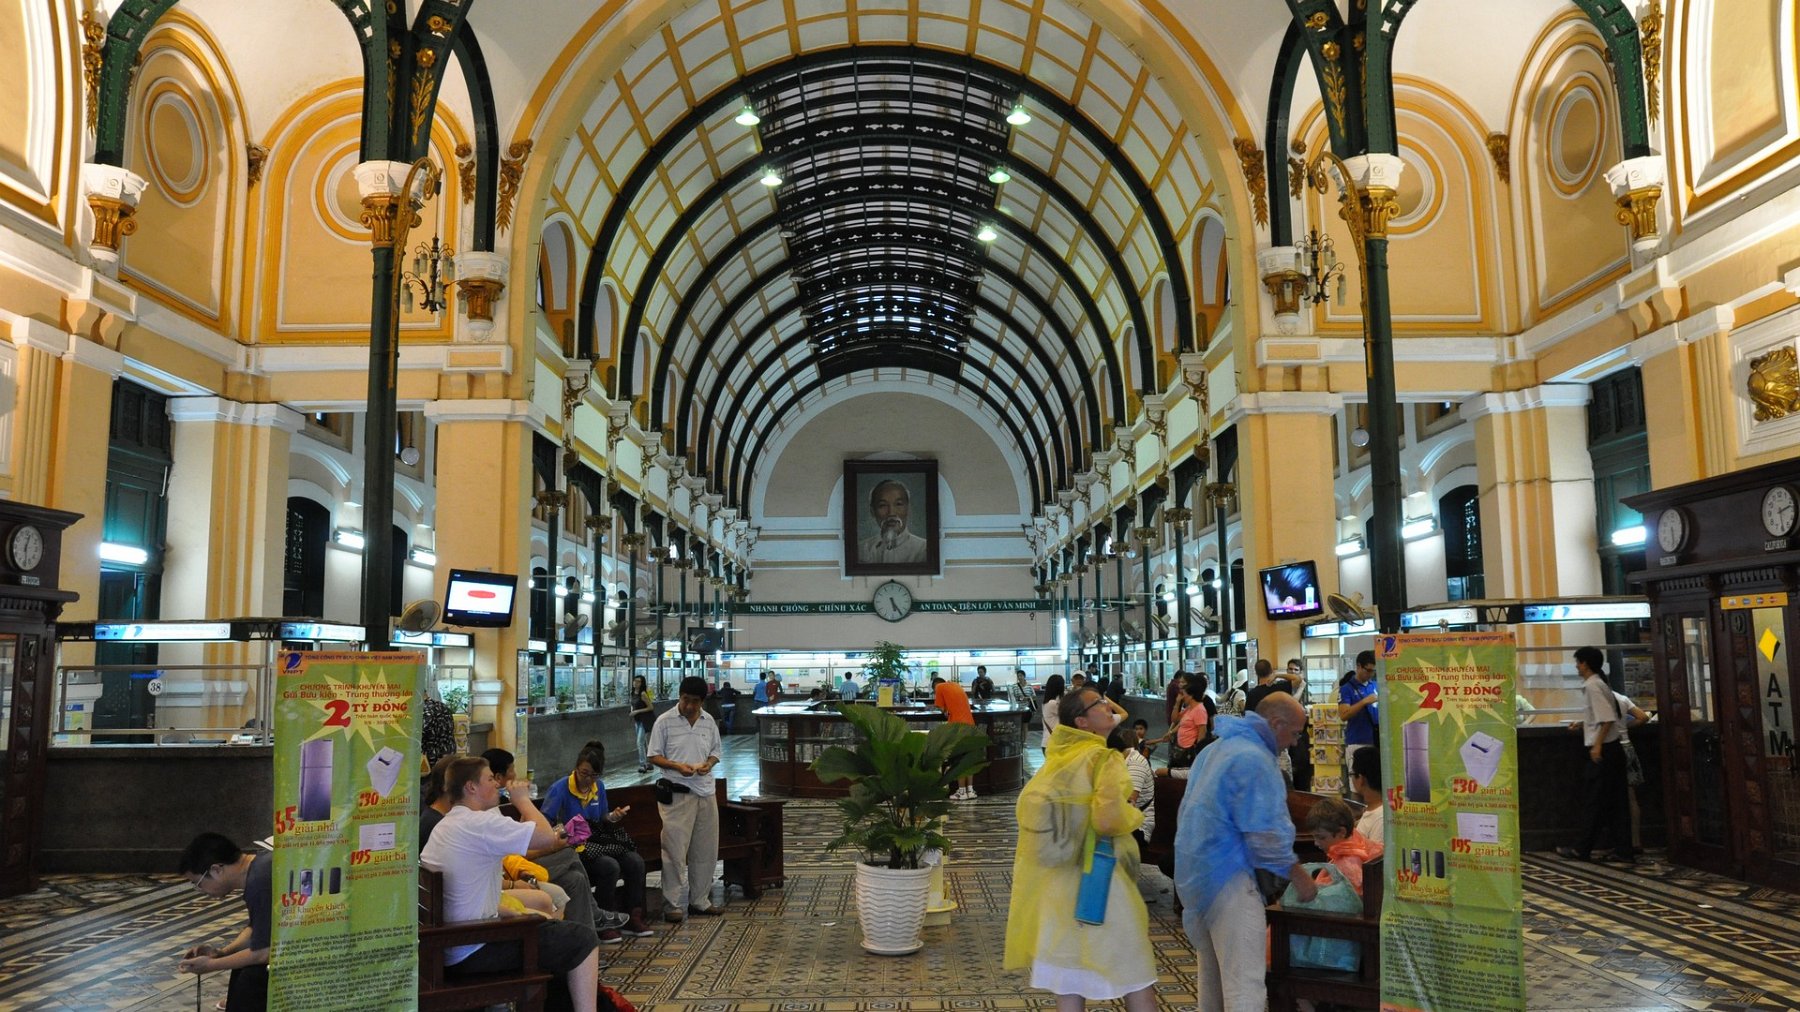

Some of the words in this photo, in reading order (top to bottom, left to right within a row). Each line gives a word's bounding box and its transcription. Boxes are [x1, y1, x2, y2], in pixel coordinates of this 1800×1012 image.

[960, 602, 976, 610] TIỆN
[150, 682, 162, 692] 38
[1418, 682, 1443, 710] 2
[1464, 682, 1502, 696] ĐỒNG
[323, 700, 352, 728] 2
[372, 699, 408, 712] ĐỒNG
[1767, 673, 1792, 756] ATM
[350, 849, 371, 865] 195
[394, 851, 406, 860] ba
[1451, 838, 1472, 854] 195
[1498, 845, 1510, 857] ba
